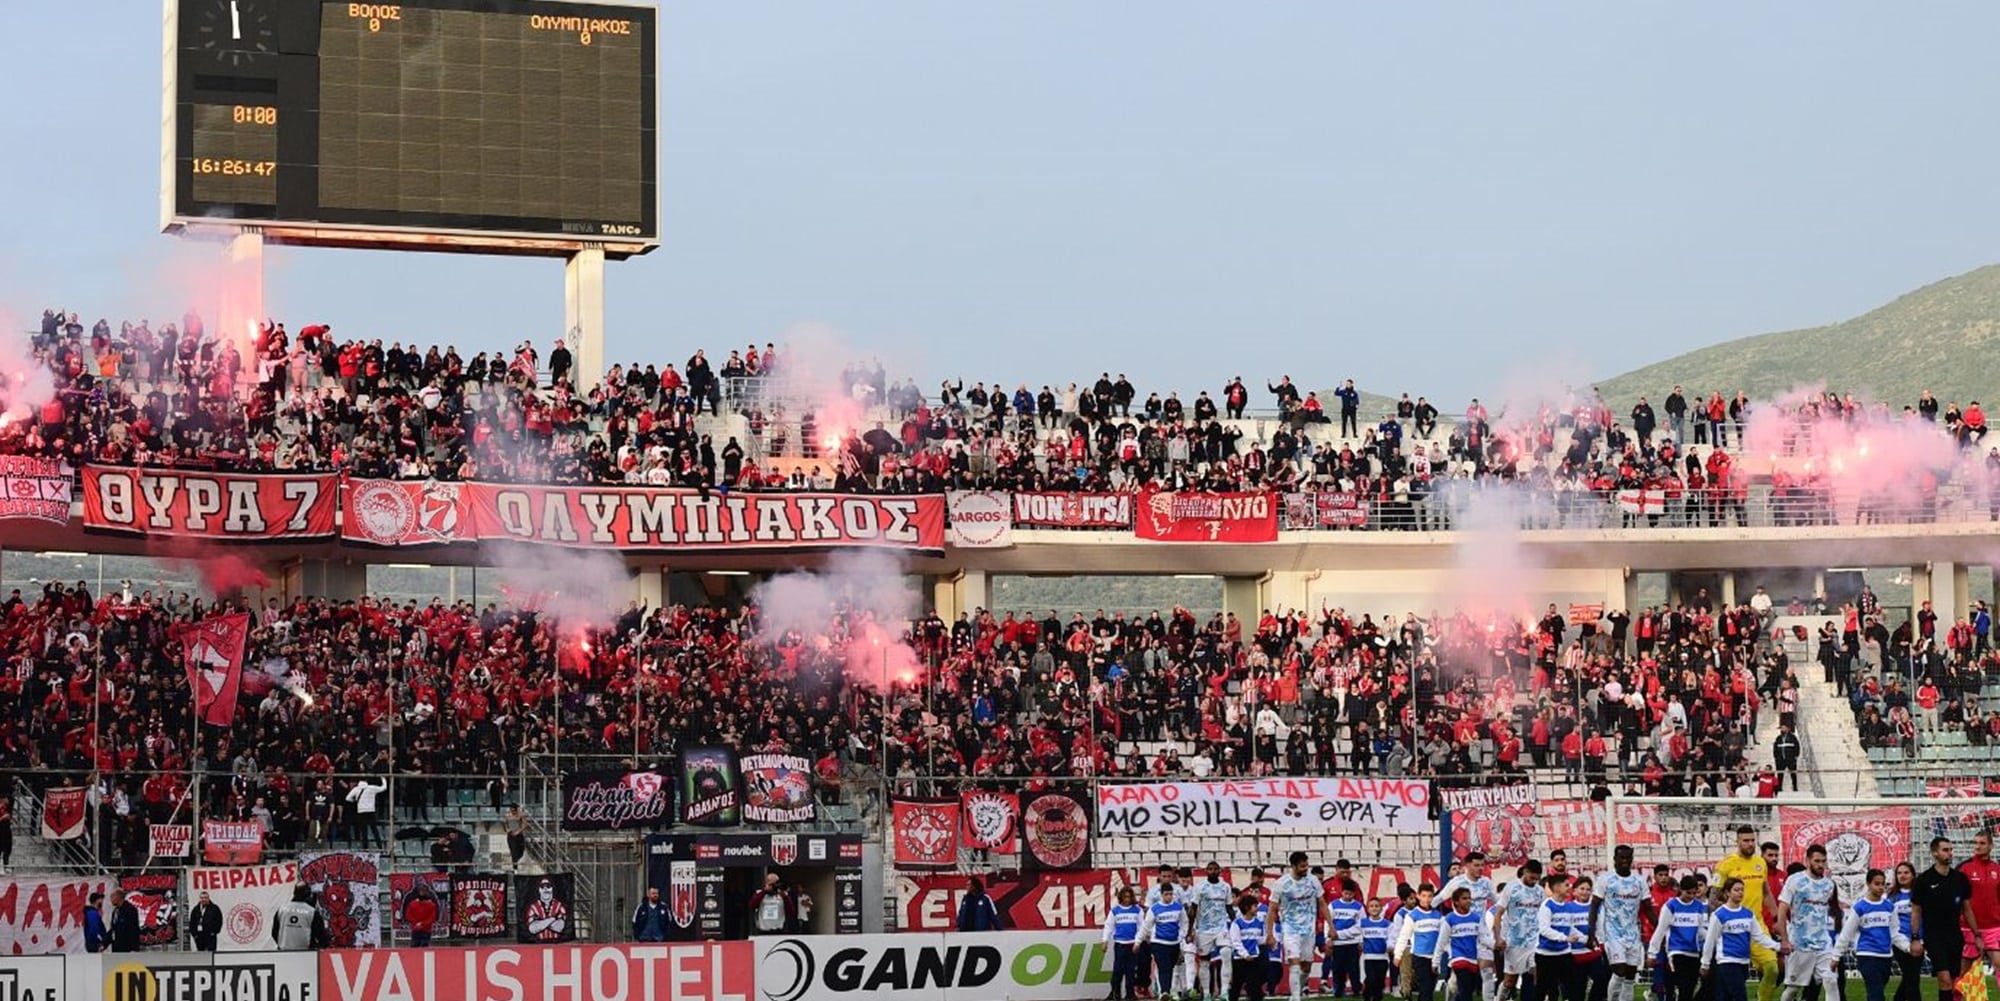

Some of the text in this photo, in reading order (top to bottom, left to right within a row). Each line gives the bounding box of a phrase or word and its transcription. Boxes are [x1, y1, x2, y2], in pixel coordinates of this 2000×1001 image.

[349, 3, 400, 20] ΒΟΛΟΣ
[370, 18, 380, 32] 0
[531, 14, 631, 34] ΟΛΥΜΠΙΑΚΟΣ
[580, 31, 592, 46] 0
[233, 105, 277, 125] 0:00
[192, 158, 277, 177] 16:26:47
[97, 473, 267, 534] ΘΥΡΑ
[283, 481, 321, 531] 7
[497, 490, 919, 544] ΟΛΥΜΠΙΑΚΟΣ
[1100, 783, 1180, 805] ΚΑΛΟ
[1337, 778, 1429, 807] ΔΗΜΟ
[1160, 801, 1281, 826] SKILLZ
[1319, 801, 1375, 824] ΘΥΡΑ
[1380, 803, 1401, 828] 7
[723, 844, 762, 856] novibet
[193, 863, 297, 890] ΠΕΙΡΑΙΑΣ
[543, 944, 747, 1001] HOTEL
[822, 942, 1114, 993] GAND OIL
